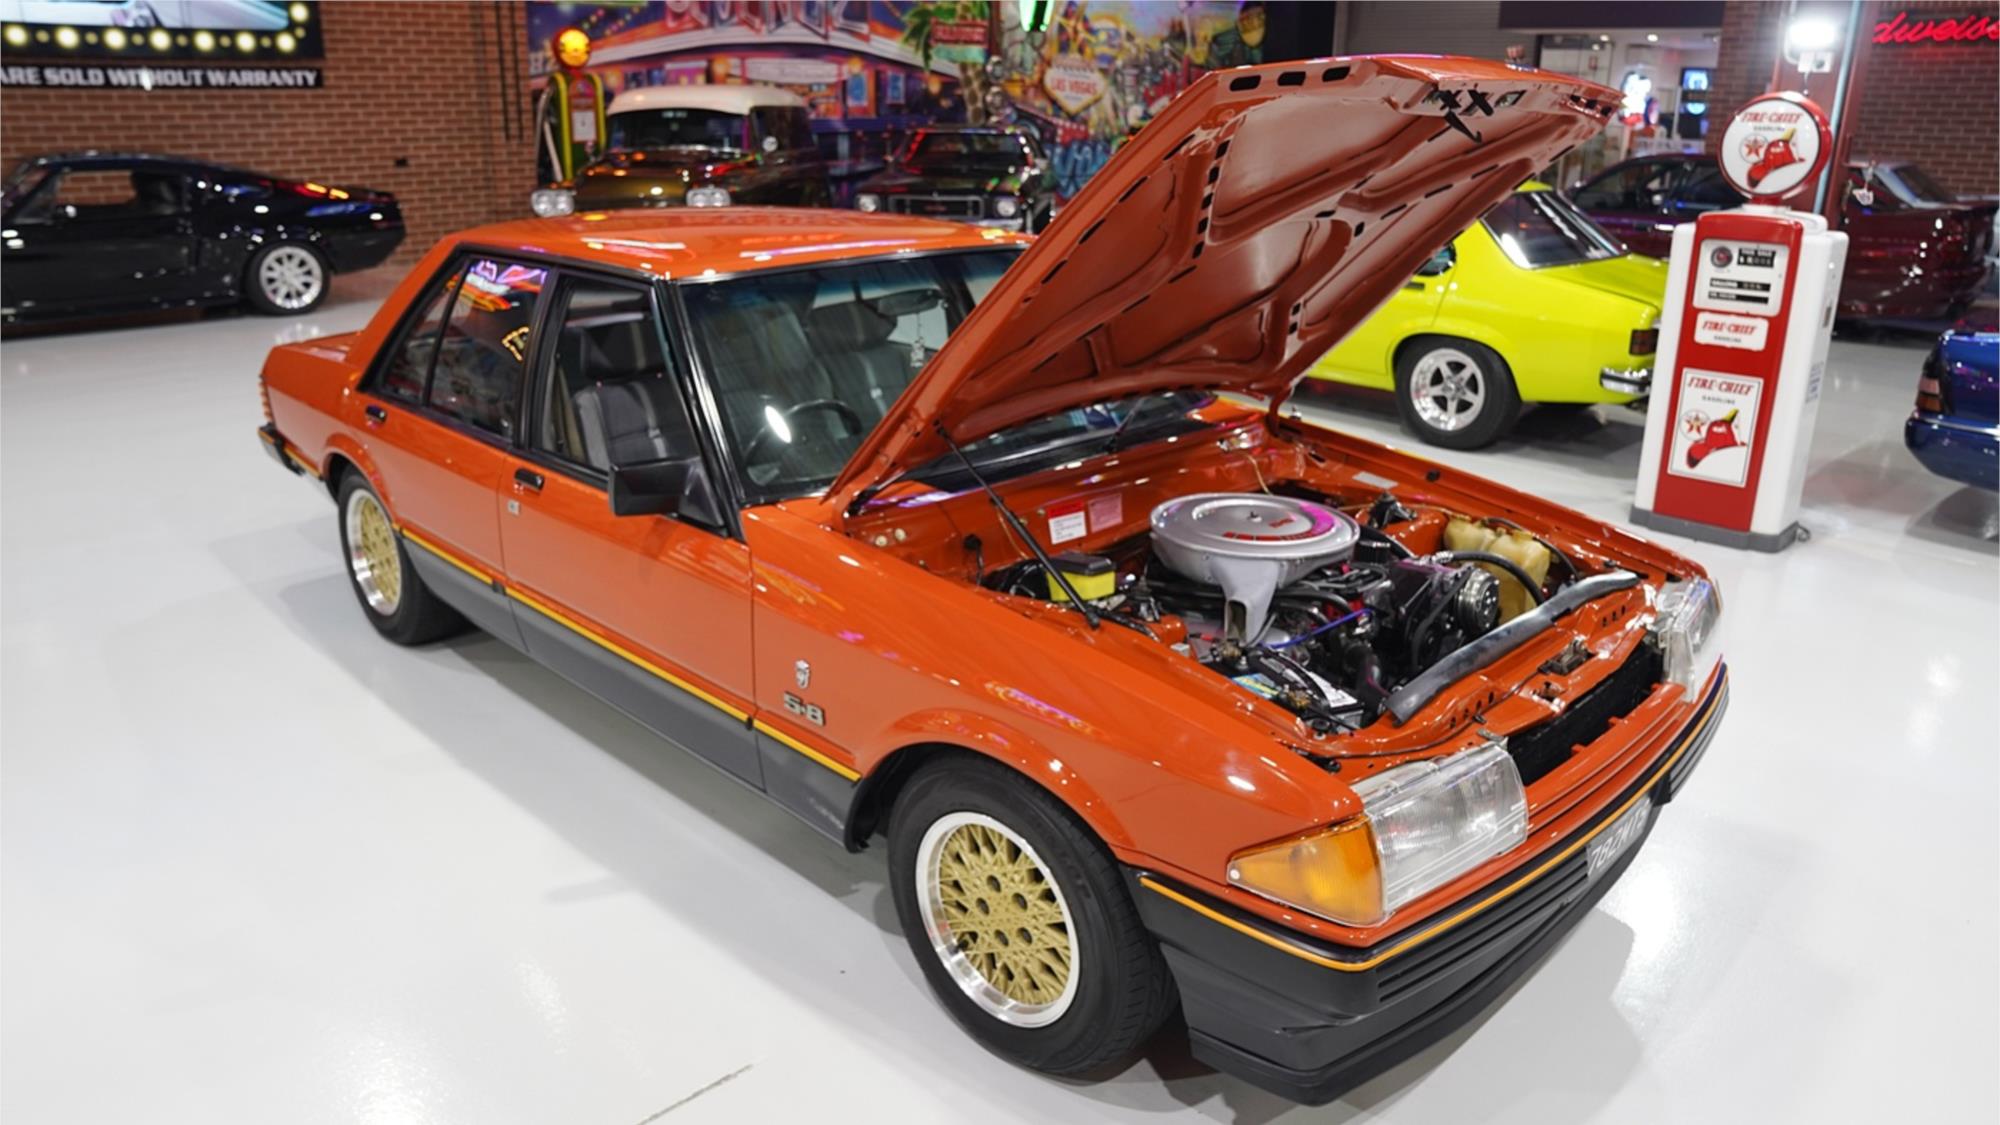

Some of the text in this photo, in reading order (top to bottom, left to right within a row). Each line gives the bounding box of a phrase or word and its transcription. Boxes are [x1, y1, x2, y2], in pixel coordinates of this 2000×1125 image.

[44, 67, 104, 85] SOLD
[107, 68, 203, 86] WITHOUT
[206, 69, 317, 86] WARRANTY
